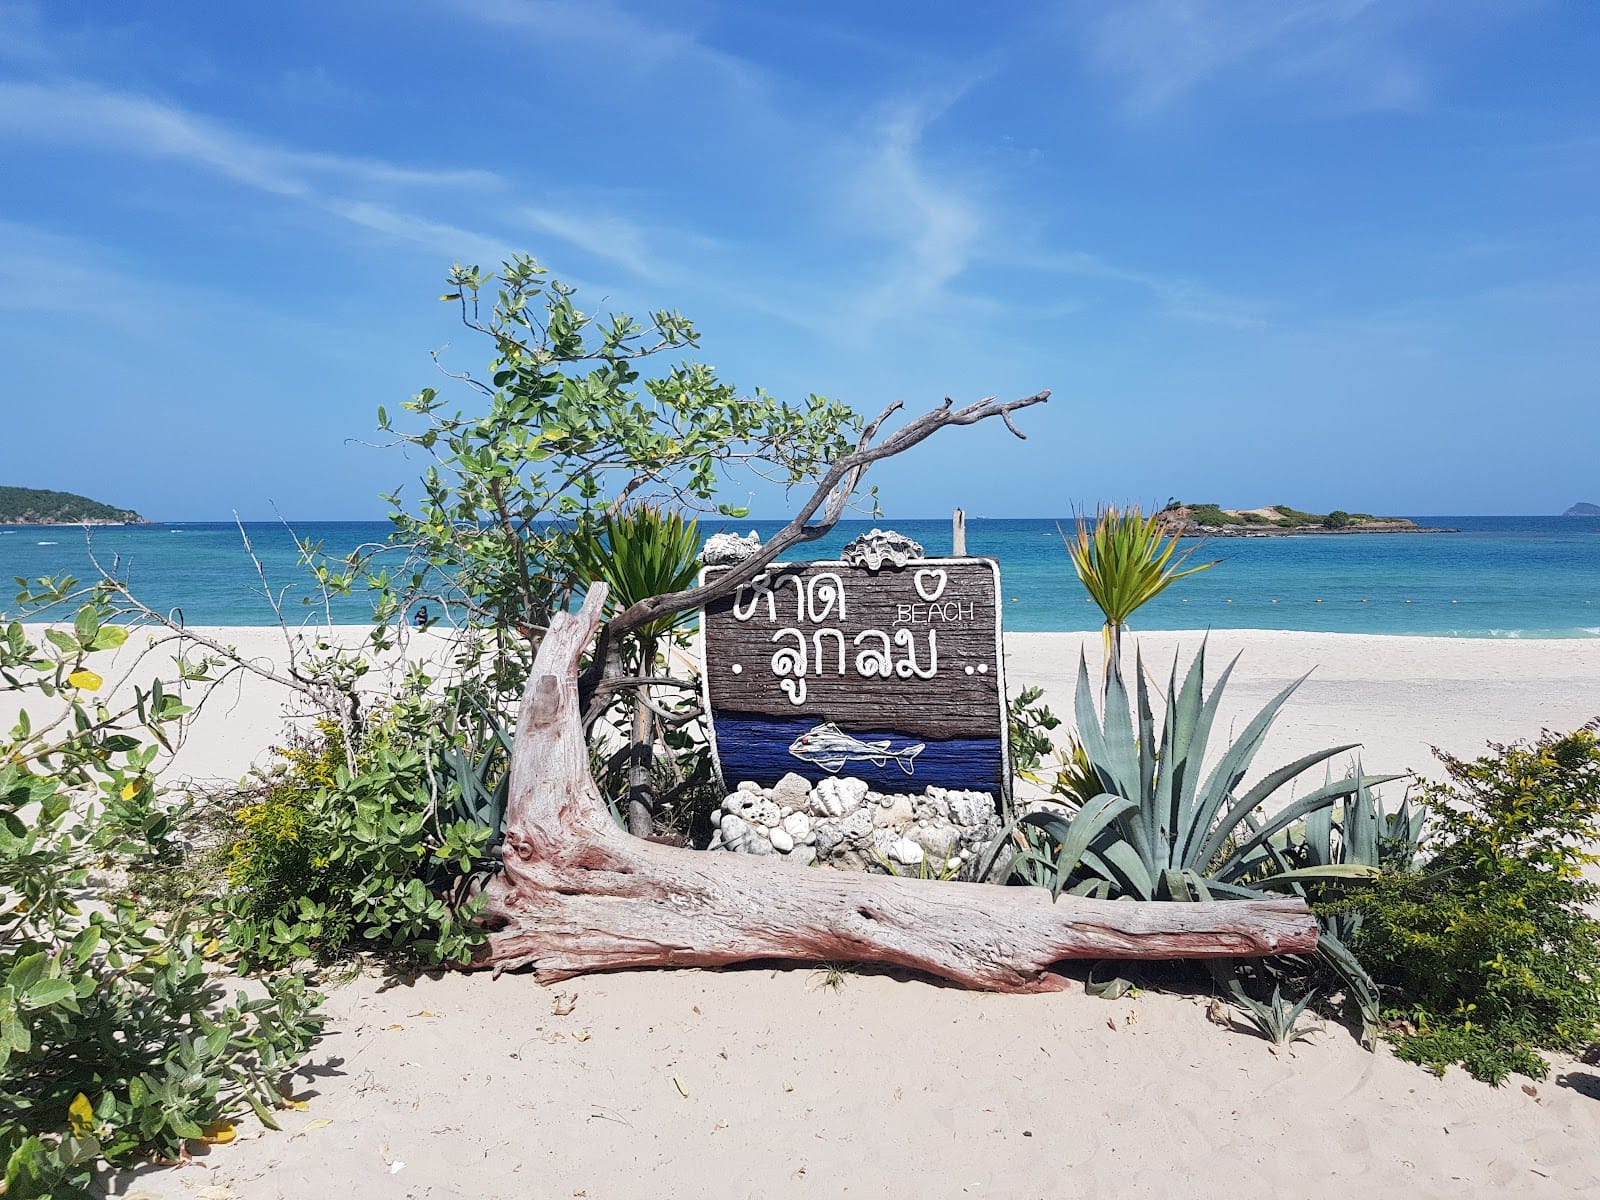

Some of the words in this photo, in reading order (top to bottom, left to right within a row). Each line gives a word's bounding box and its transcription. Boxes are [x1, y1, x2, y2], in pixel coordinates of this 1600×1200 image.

[733, 572, 846, 623] หาด
[893, 602, 974, 626] BEACH
[771, 628, 938, 705] ลูกลม
